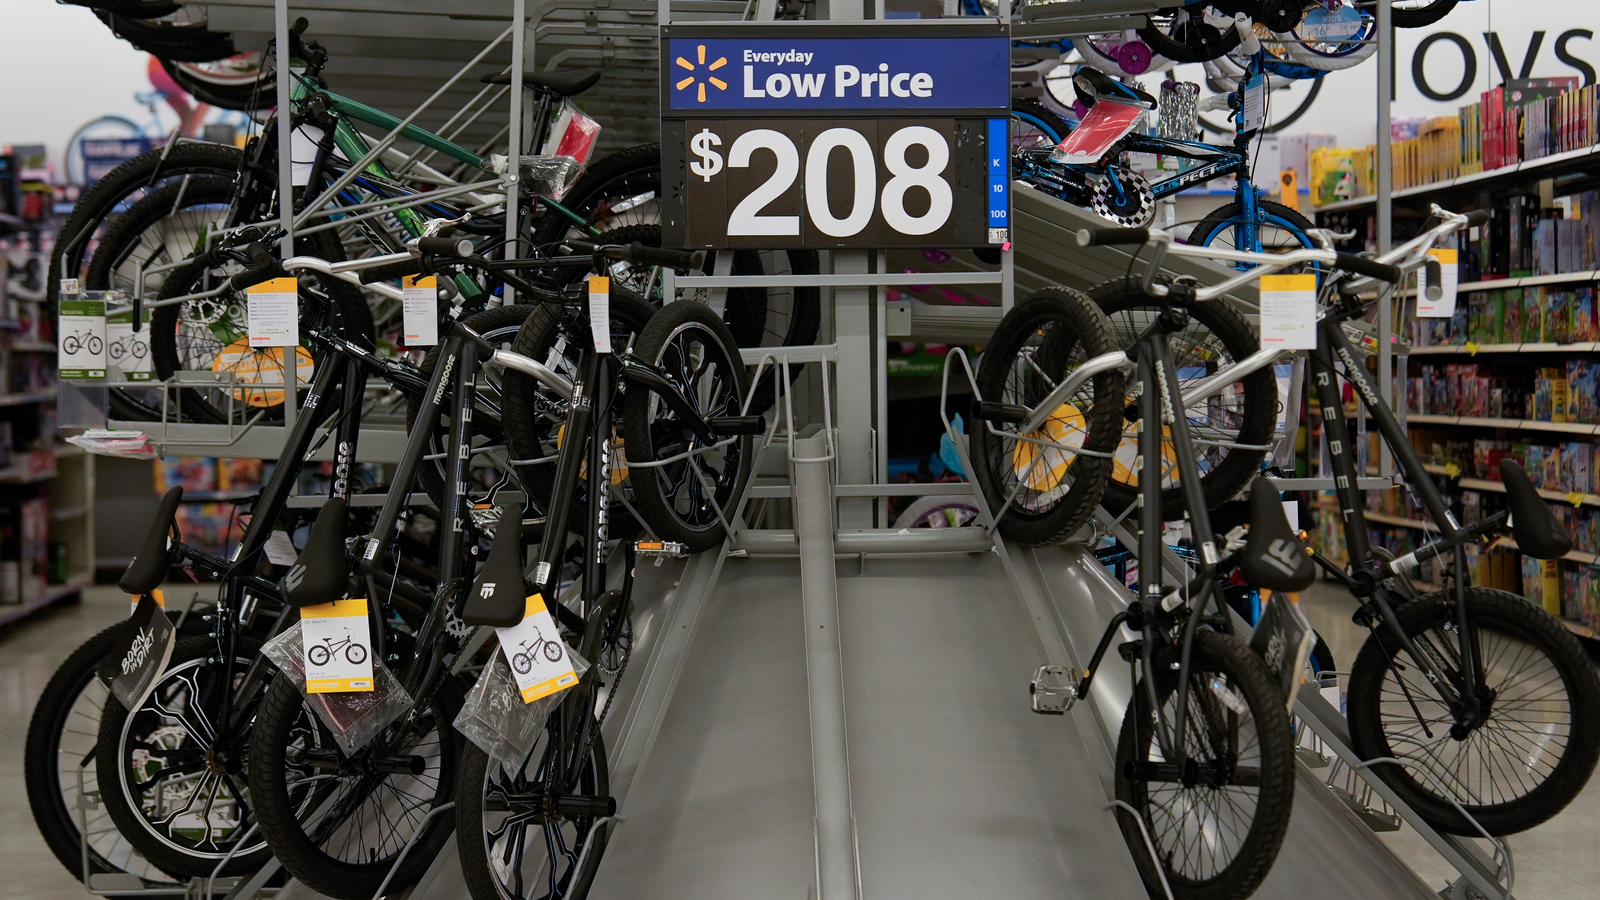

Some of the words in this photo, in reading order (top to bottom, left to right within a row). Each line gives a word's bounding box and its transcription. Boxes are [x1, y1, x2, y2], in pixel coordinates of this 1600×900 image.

[743, 49, 814, 66] Everyday
[743, 64, 827, 98] Low
[834, 62, 934, 98] Price
[1391, 27, 1598, 103] oys
[689, 125, 954, 238] $208
[993, 159, 1000, 167] K
[993, 184, 1003, 193] 10
[990, 210, 1007, 218] 100
[433, 354, 456, 405] mongoose
[1155, 360, 1176, 424] mongoose
[1338, 347, 1378, 406] mongoose
[453, 373, 475, 532] REBEL
[1317, 371, 1354, 523] REBEL
[121, 626, 147, 675] BORN
[130, 659, 138, 673] IN
[136, 627, 155, 668] DIRT
[1426, 670, 1439, 684] X1
